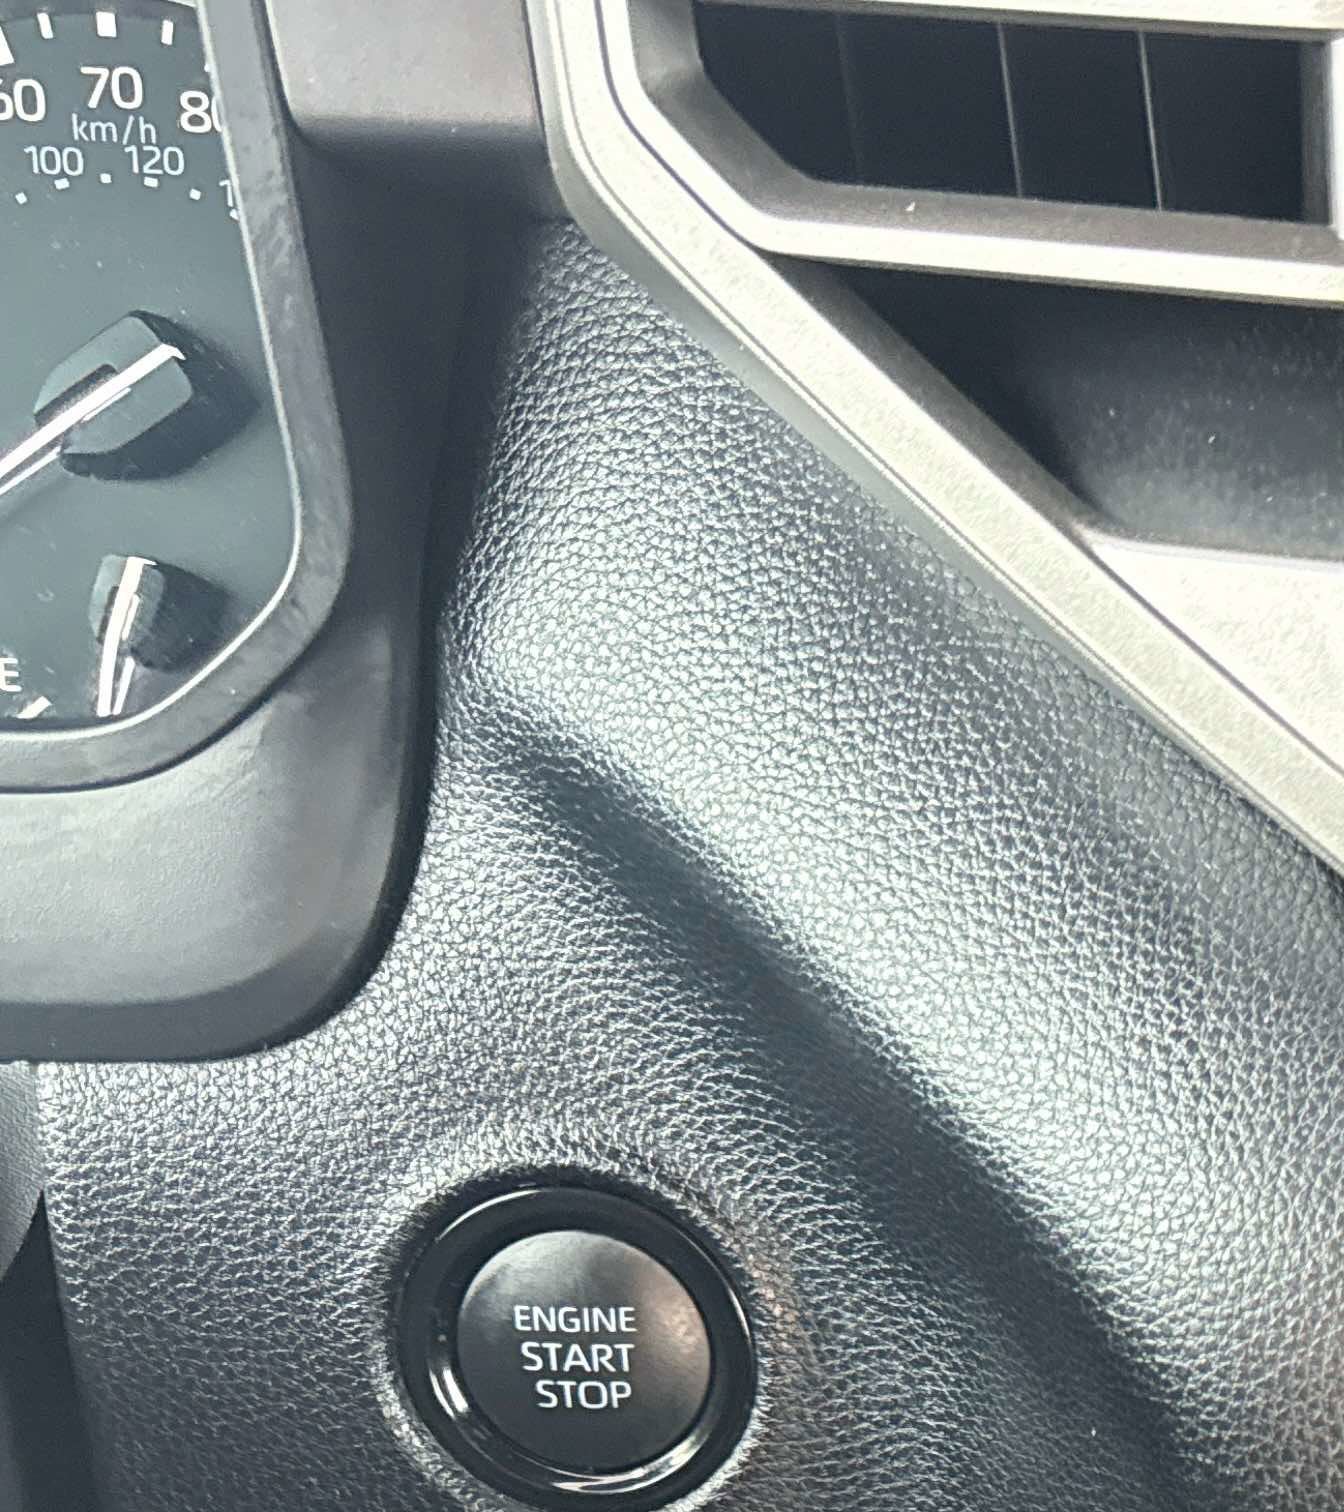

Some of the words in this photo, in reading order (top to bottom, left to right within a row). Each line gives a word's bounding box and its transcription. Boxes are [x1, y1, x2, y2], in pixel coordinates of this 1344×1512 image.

[80, 66, 143, 110] 70
[72, 113, 157, 146] km/h
[24, 145, 84, 176] 100
[124, 145, 185, 176] 120
[0, 658, 22, 692] E
[513, 1304, 637, 1333] ENGINE
[520, 1341, 635, 1373] START
[535, 1379, 632, 1409] STOP
